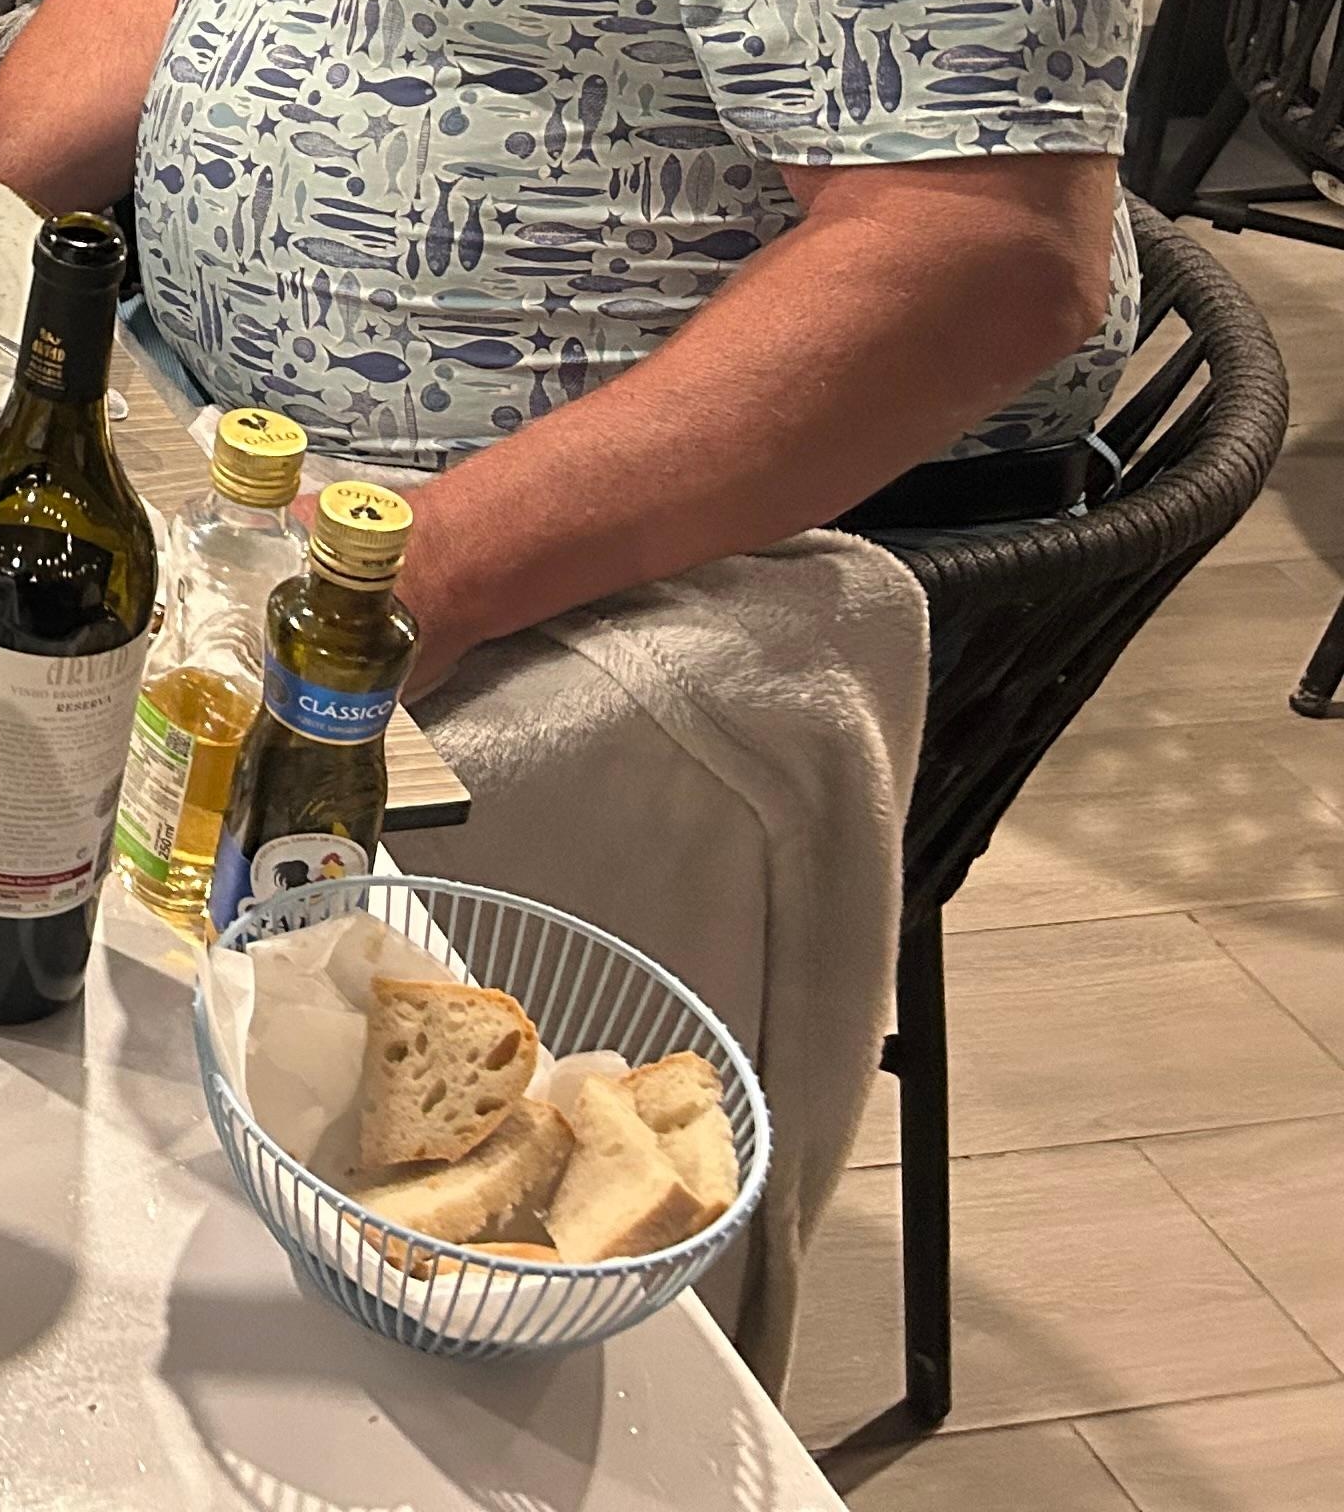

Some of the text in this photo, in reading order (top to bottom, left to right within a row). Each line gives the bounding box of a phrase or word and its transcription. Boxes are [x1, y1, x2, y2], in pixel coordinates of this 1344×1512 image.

[243, 430, 300, 447] GALLO
[337, 487, 399, 510] GALLO
[56, 694, 112, 713] RESERVA
[298, 695, 393, 721] CLÁSSICO
[158, 838, 172, 862] 250
